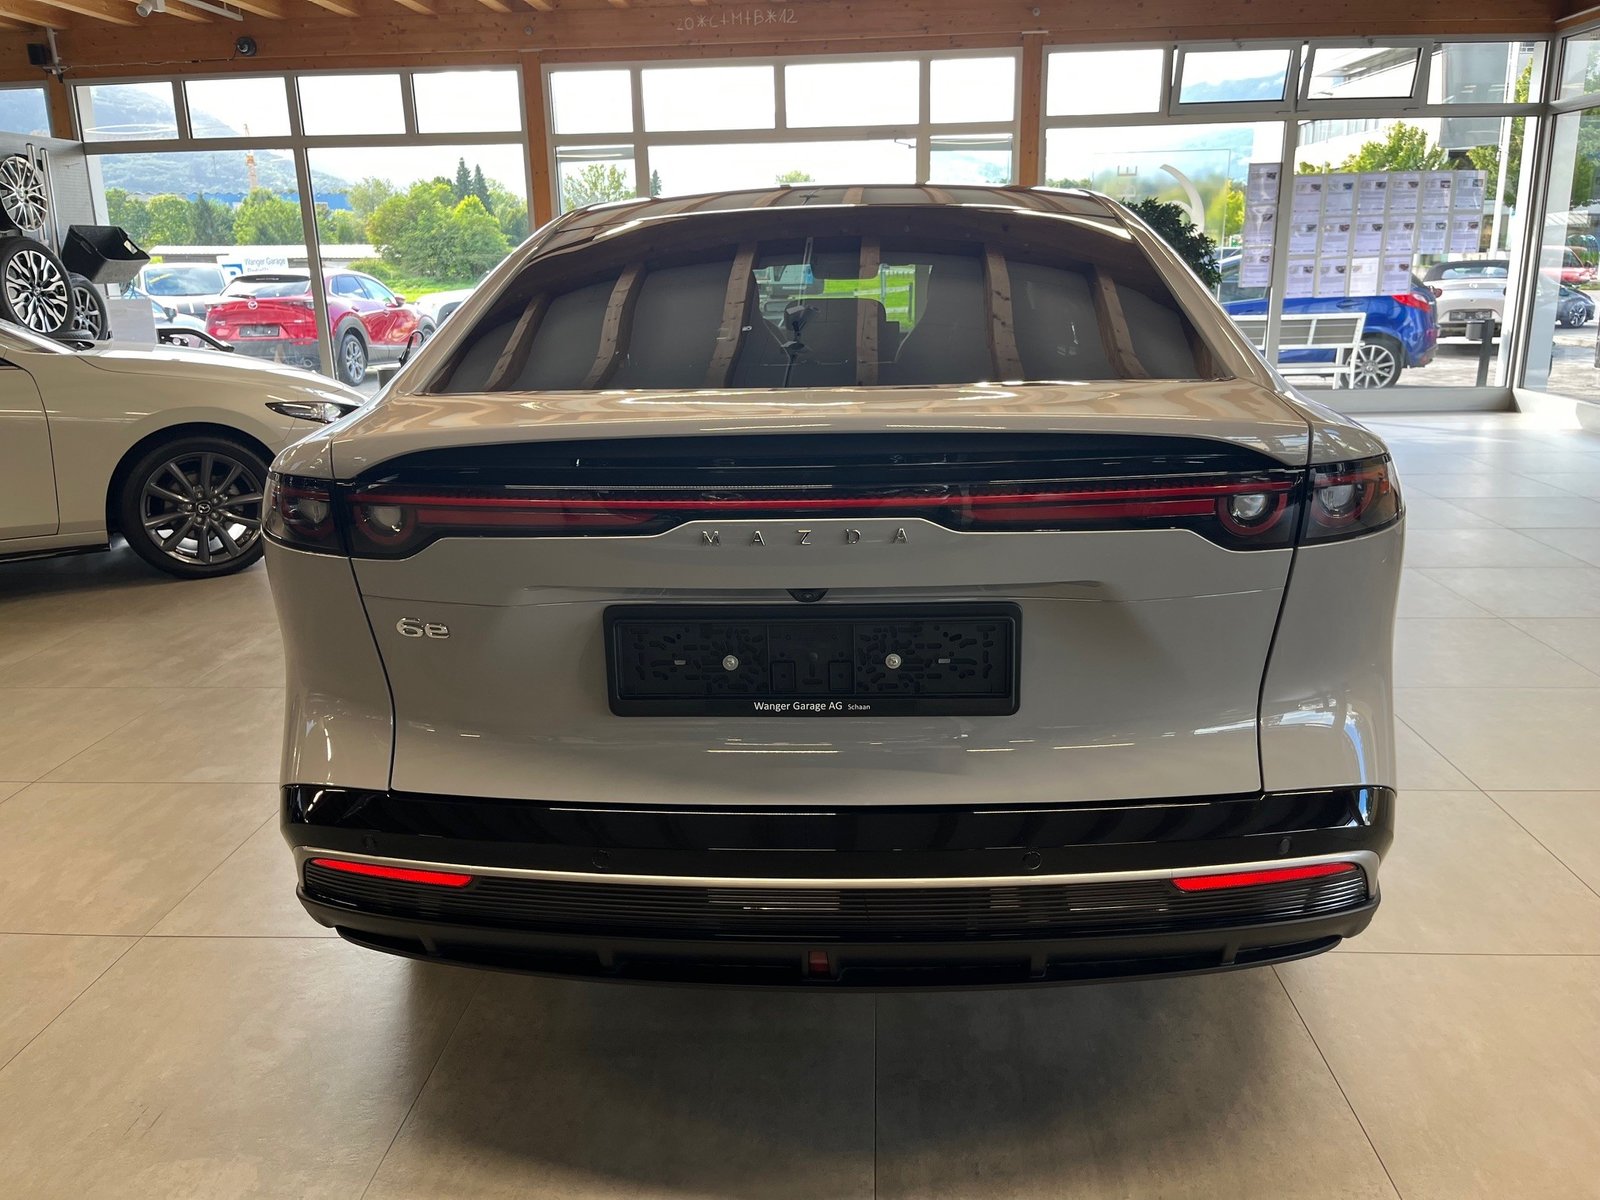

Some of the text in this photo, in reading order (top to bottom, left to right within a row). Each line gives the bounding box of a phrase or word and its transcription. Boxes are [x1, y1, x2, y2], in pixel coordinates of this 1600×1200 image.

[702, 527, 910, 546] MAZDA
[396, 617, 450, 639] 6e
[753, 701, 871, 713] Wanger Garage AG Schaan
